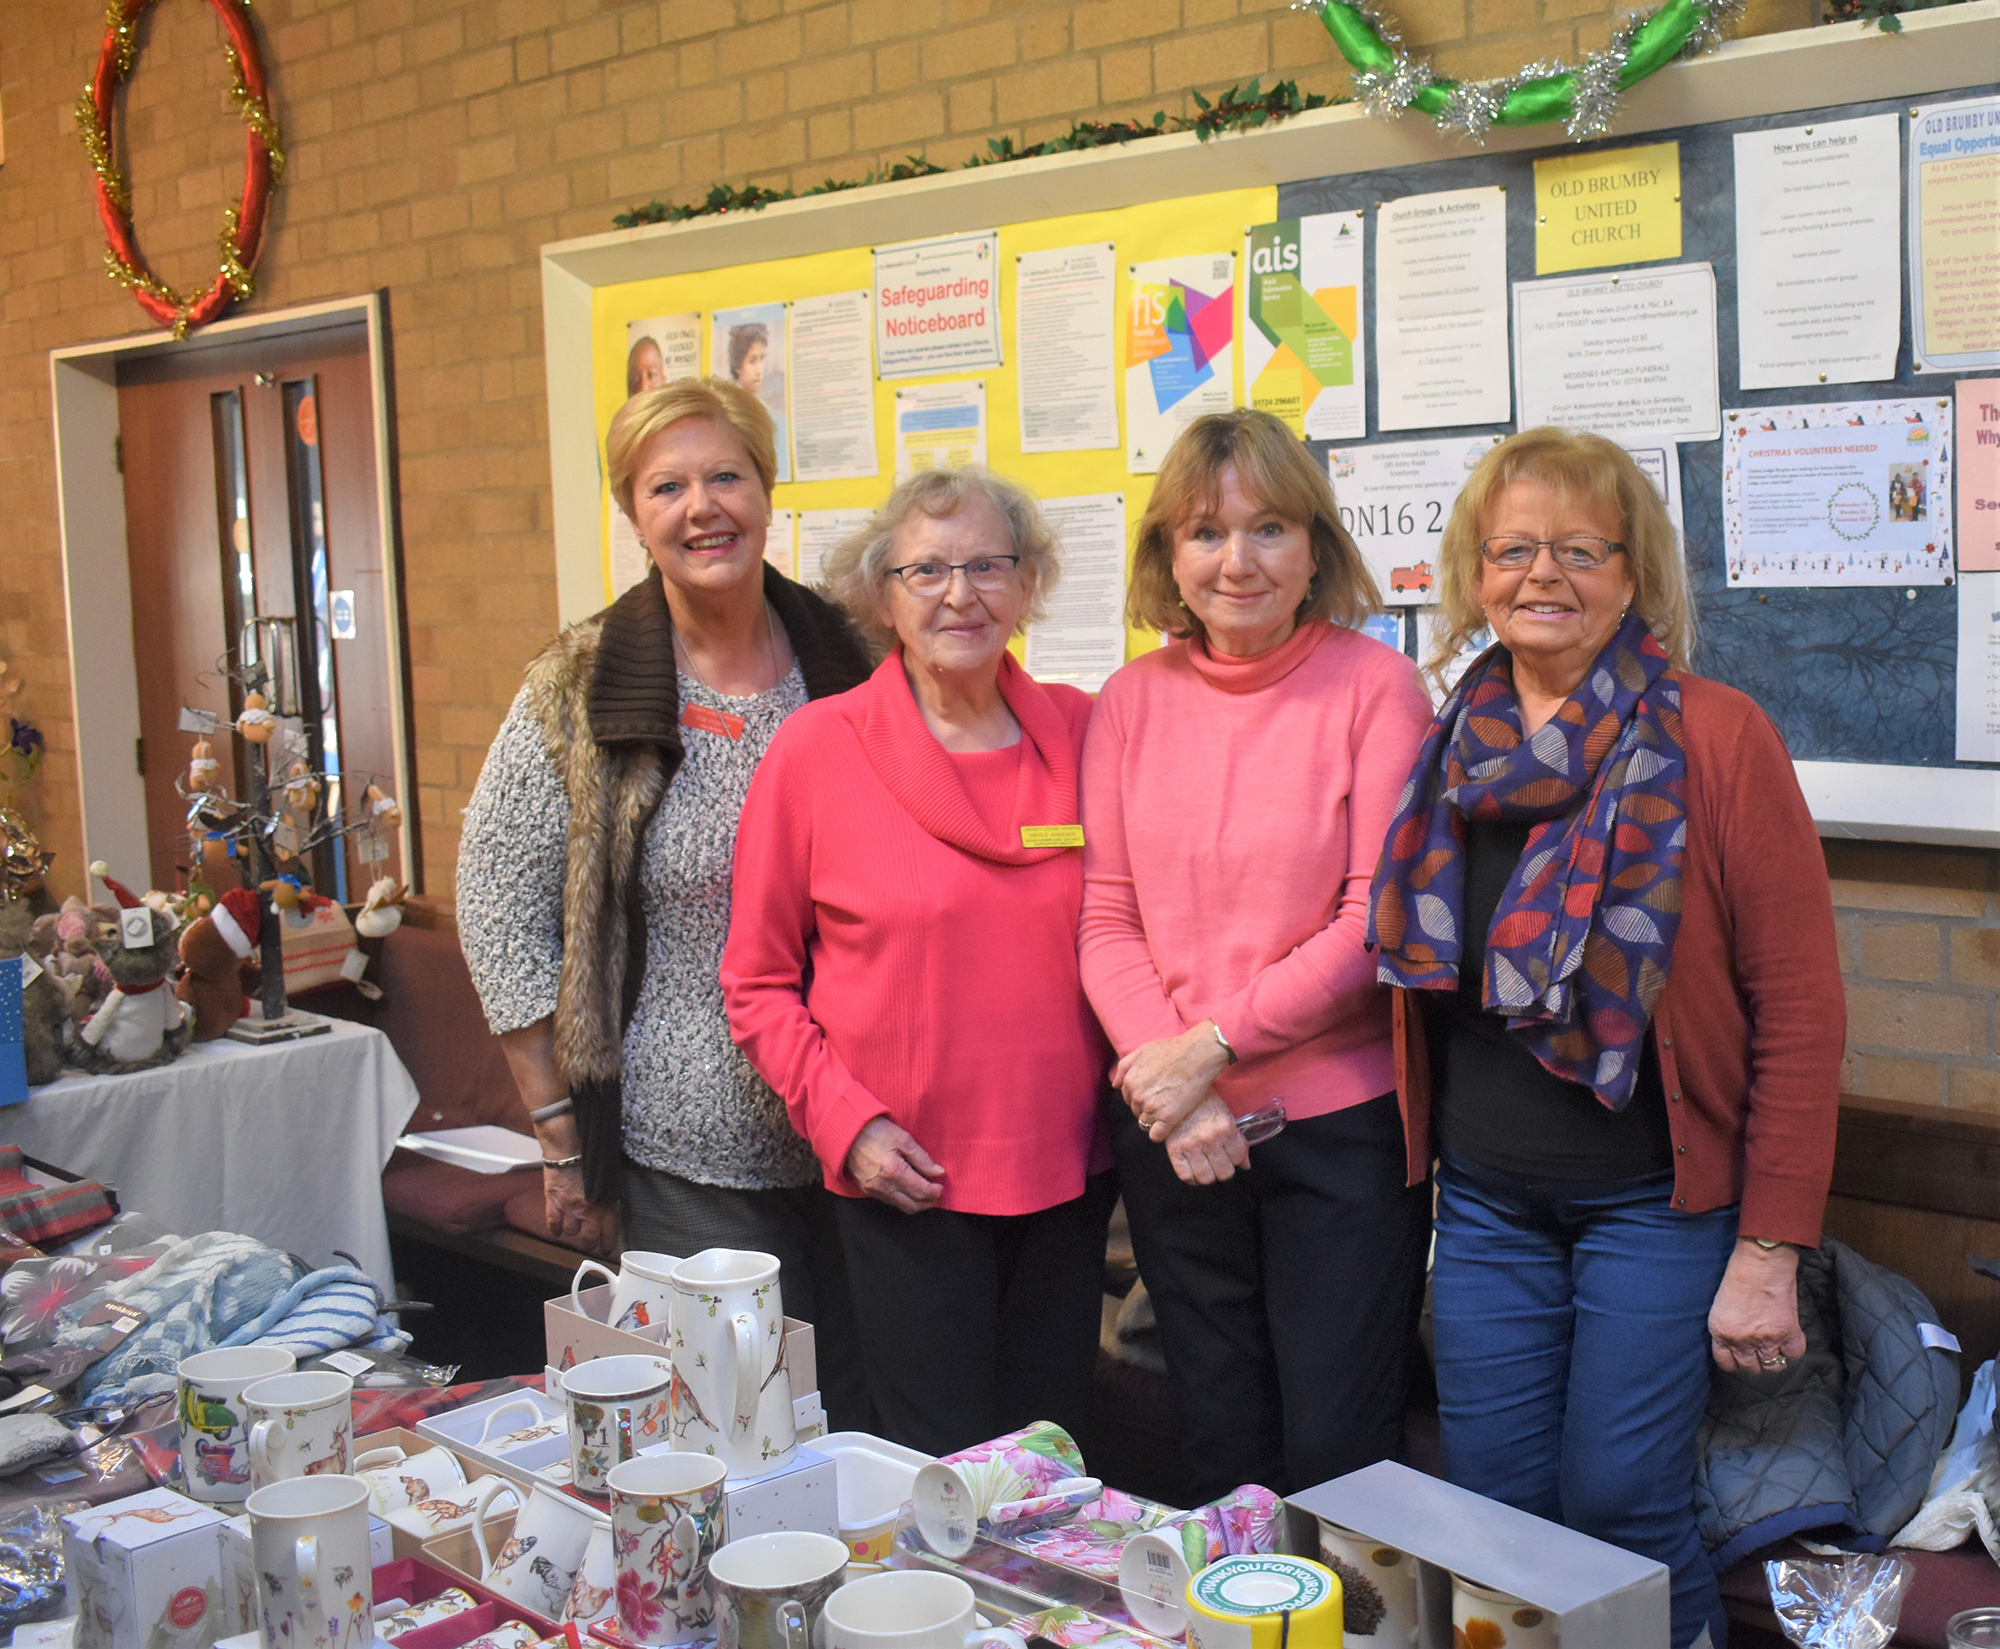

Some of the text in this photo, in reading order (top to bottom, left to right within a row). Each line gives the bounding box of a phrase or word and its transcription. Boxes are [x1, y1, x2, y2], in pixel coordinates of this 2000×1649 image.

[1925, 118, 1943, 135] OLD
[1946, 112, 1985, 132] BRUMBY
[1774, 135, 1858, 153] How you can help us
[1920, 139, 1952, 158] Equal
[1550, 168, 1661, 198] OLD BRUMBY
[1392, 201, 1481, 221] Church Groups & Activities
[1575, 199, 1637, 221] UNITED
[1571, 223, 1642, 246] CHURCH
[1252, 235, 1299, 275] ais
[881, 276, 989, 308] Safeguarding
[885, 306, 986, 339] Noticeboard
[1979, 404, 2000, 422] Th
[1748, 444, 1879, 459] CHRISTMAS VOLUNTEERS NEEDED!
[1975, 498, 2000, 511] Se
[1339, 501, 1443, 538] DN16 2
[1201, 1568, 1231, 1594] THANK
[1229, 1562, 1261, 1576] YOU
[1262, 1562, 1296, 1573] FOR
[1292, 1568, 1318, 1588] YOUR
